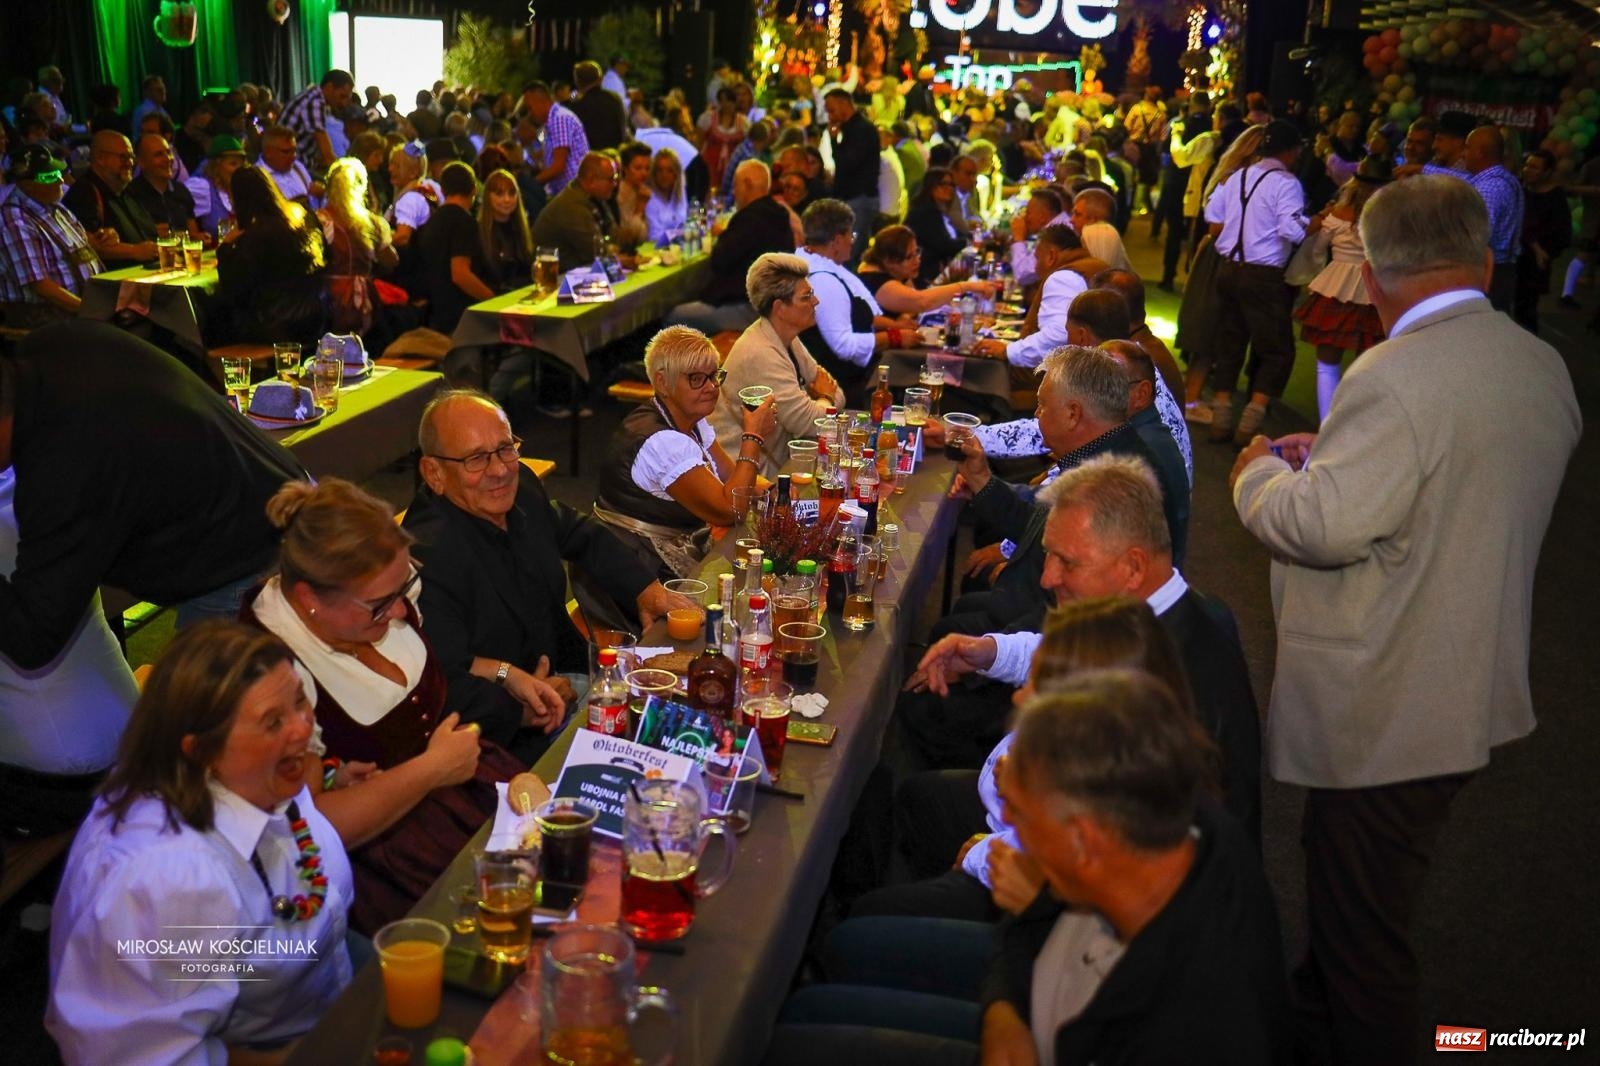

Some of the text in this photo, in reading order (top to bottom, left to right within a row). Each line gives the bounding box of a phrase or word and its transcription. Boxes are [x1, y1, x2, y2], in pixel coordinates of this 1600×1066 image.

[592, 739, 668, 769] Oktoberfest
[580, 782, 619, 801] UBOJNIA
[609, 805, 626, 818] FAS
